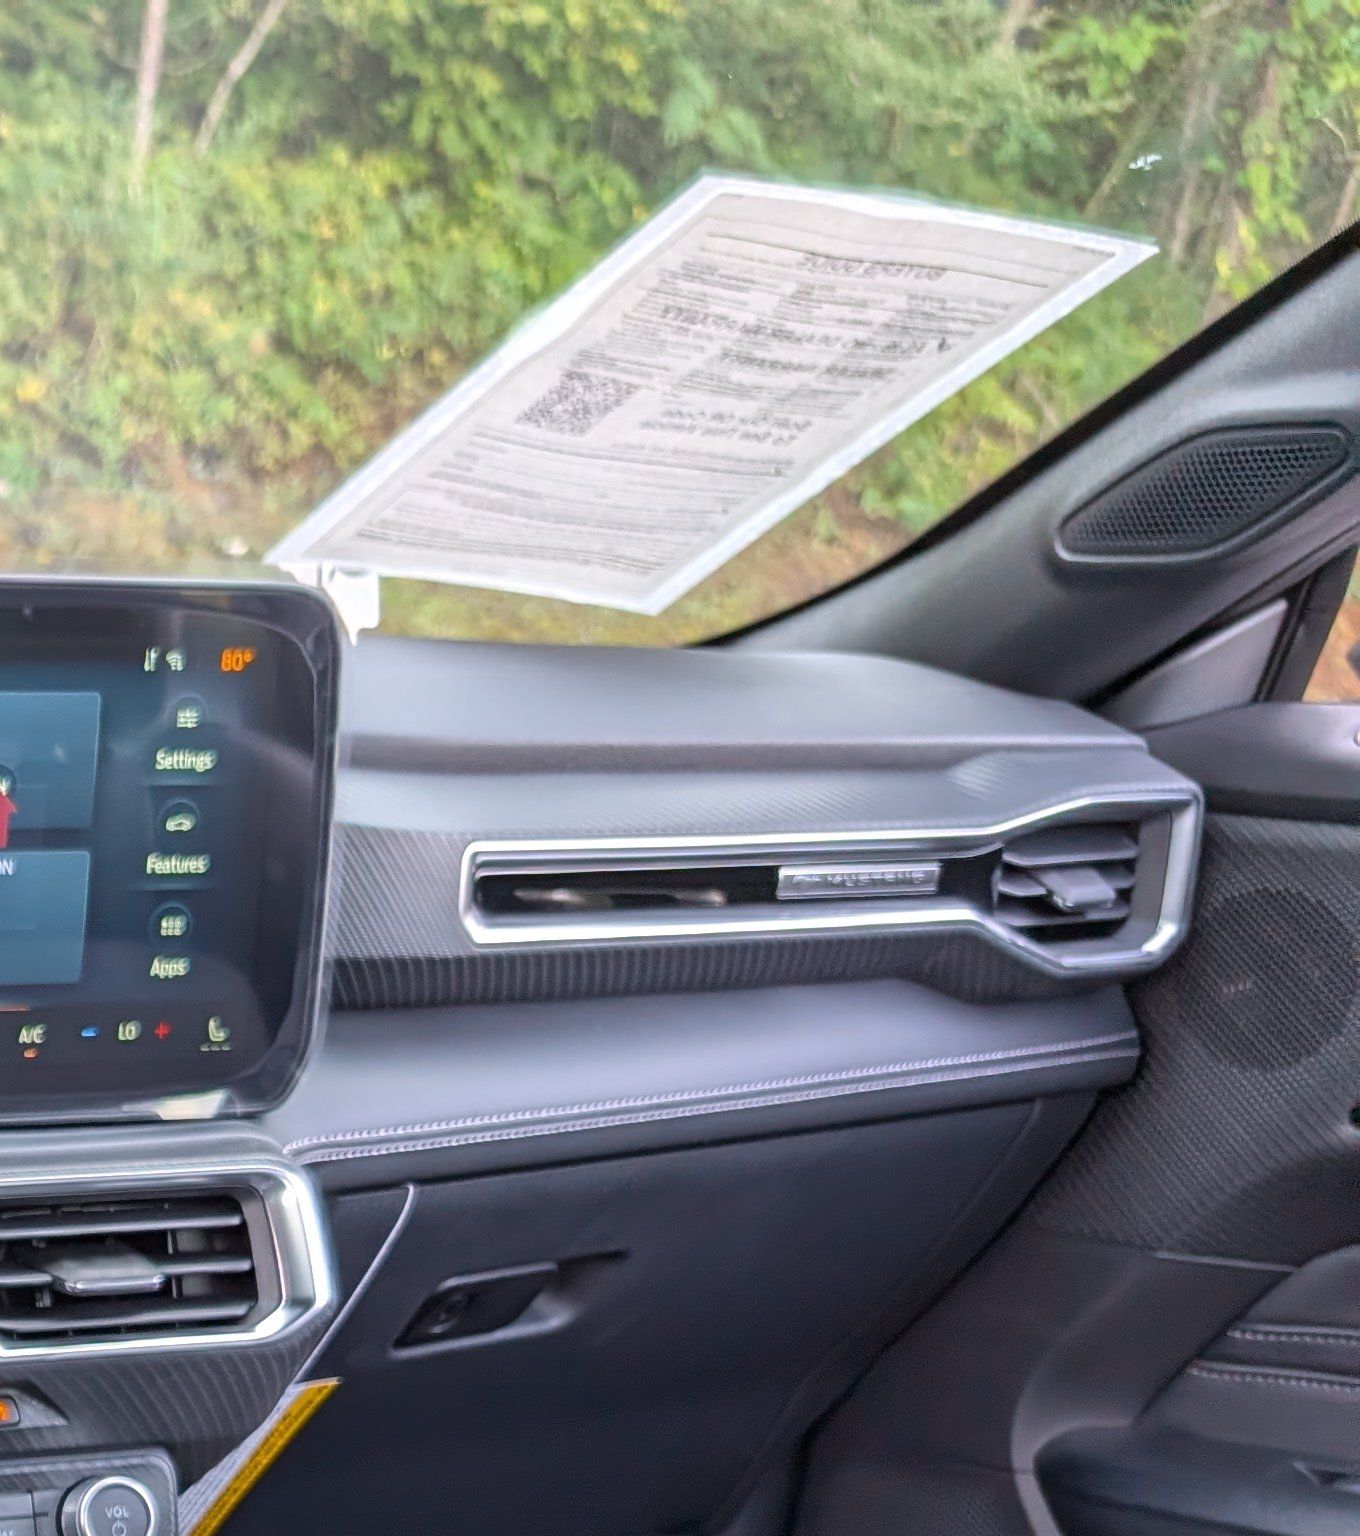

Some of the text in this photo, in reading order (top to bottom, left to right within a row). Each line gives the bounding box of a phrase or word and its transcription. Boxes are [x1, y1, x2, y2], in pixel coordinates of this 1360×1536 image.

[156, 751, 216, 772] Settings
[146, 854, 209, 874] Features
[150, 957, 189, 978] Apps
[18, 1025, 47, 1044] A/C
[118, 1020, 141, 1040] LO
[105, 1505, 130, 1519] VOL
